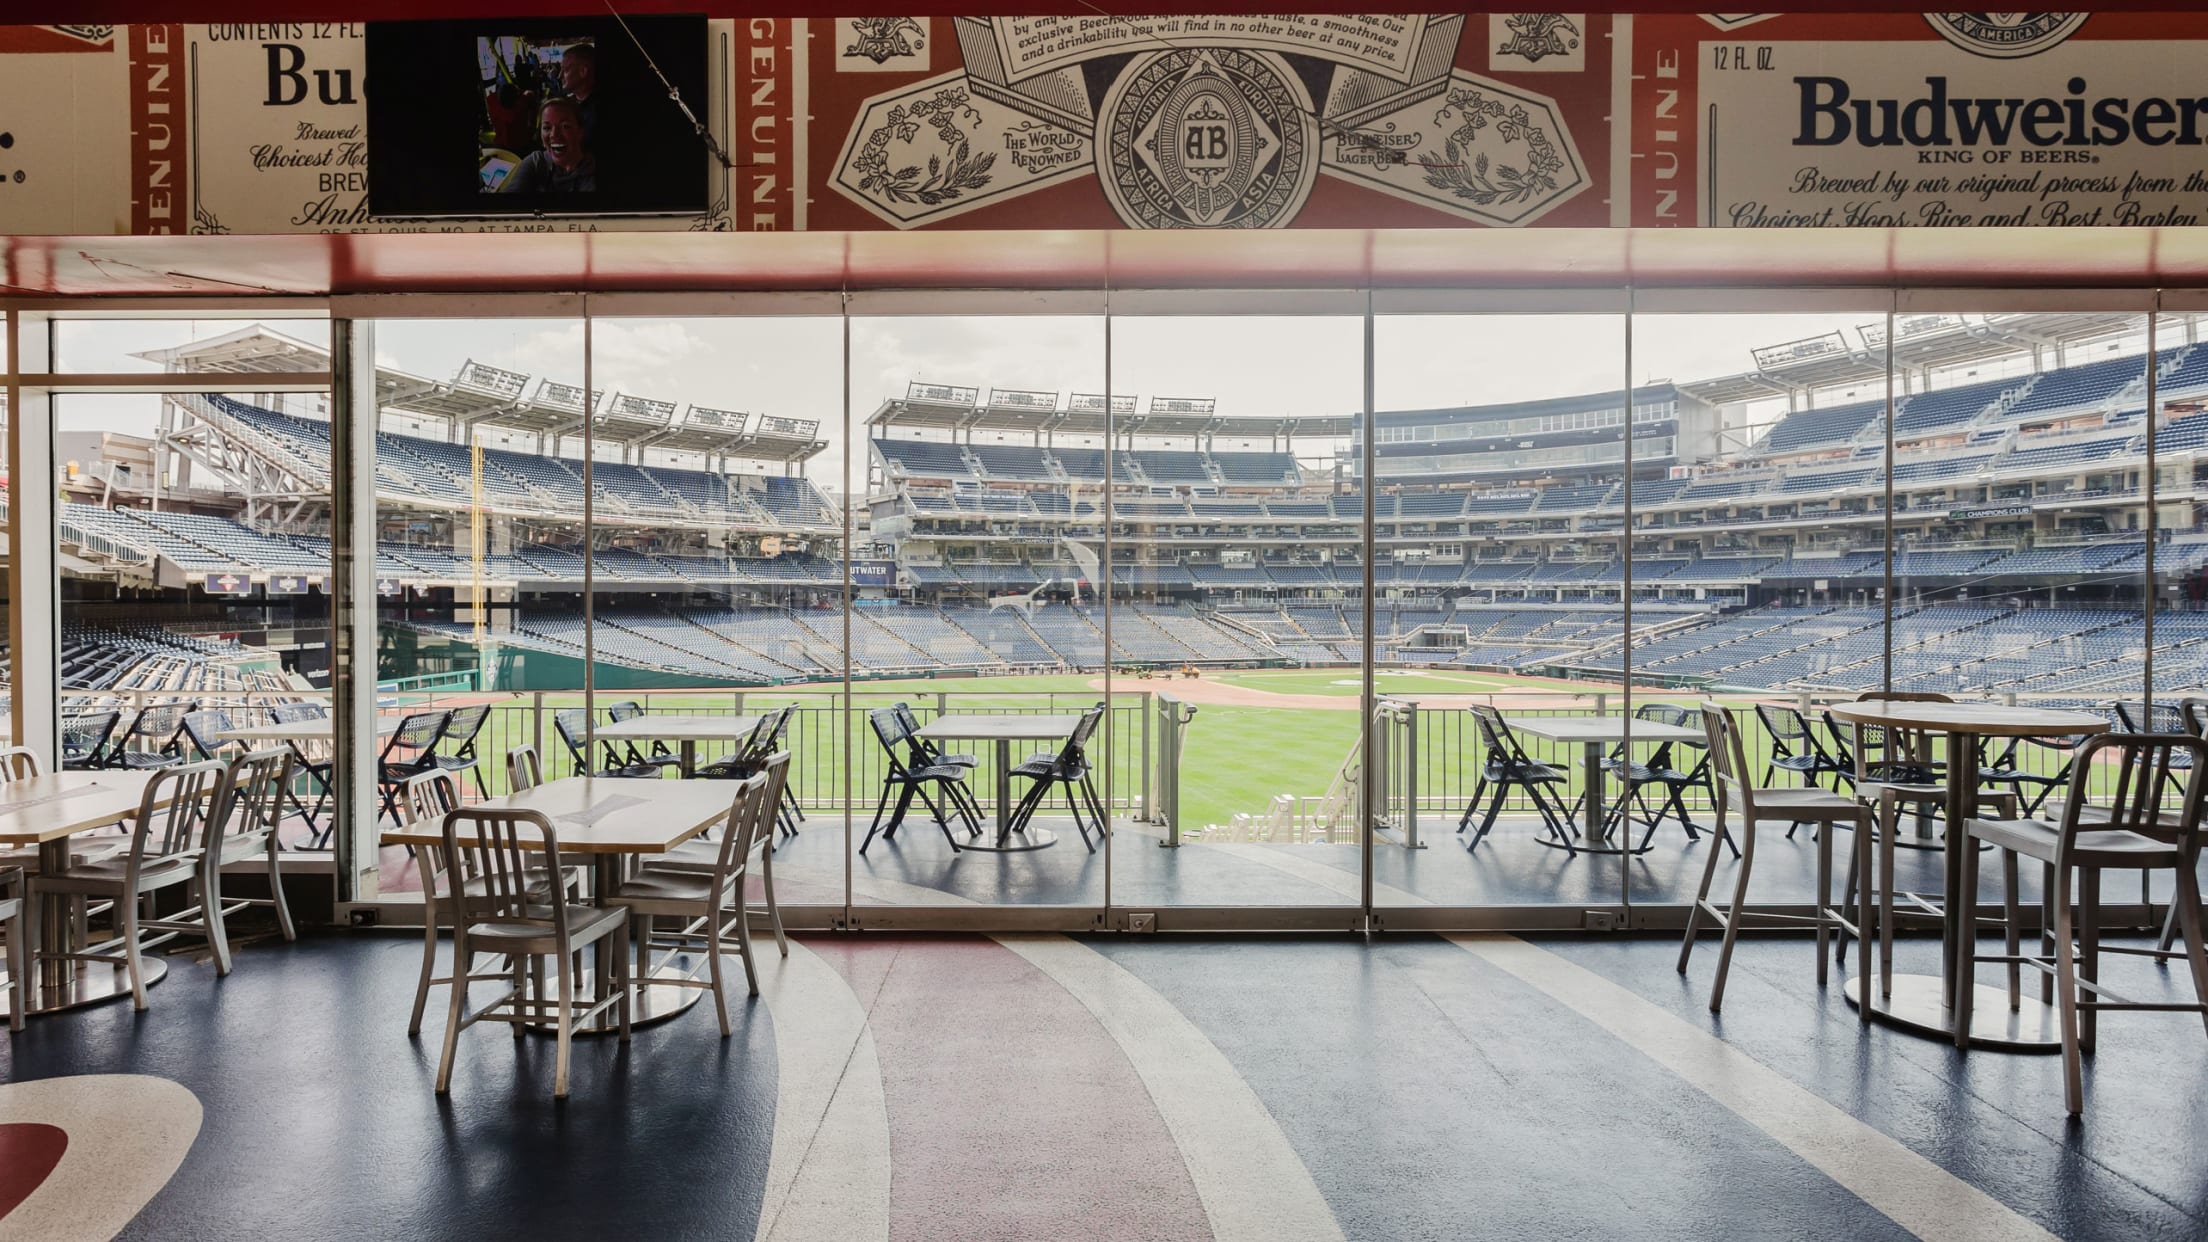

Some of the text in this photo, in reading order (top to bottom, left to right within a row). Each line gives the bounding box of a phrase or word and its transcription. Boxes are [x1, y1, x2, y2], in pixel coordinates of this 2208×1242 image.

[1014, 24, 1029, 36] by
[1035, 15, 1058, 29] any
[1018, 25, 1074, 48] exclusive
[1310, 17, 1319, 26] a
[1323, 20, 1400, 48] smoothness
[1382, 18, 1405, 34] Our
[1979, 28, 2034, 42] AMERICA
[1021, 20, 1396, 62] and a drinkability you will find in no other beer at any price.
[1713, 46, 1728, 70] 12
[1136, 79, 1178, 129] AUSTRALIA
[1238, 80, 1276, 123] EUROPE
[1792, 76, 2208, 147] Budweiser
[294, 120, 361, 141] Brewed
[750, 18, 776, 231] GENUINE
[1655, 48, 1679, 227] NUINE
[1002, 131, 1080, 150] THE WORLD
[1185, 126, 1228, 160] AB
[249, 144, 334, 172] Choicest
[1011, 150, 1082, 168] RENOWNED
[1335, 147, 1375, 165] LAGER
[1918, 150, 1974, 164] KING
[1982, 150, 2012, 164] OF
[1137, 167, 1174, 211] AFRICA
[1242, 172, 1275, 209] ASIA
[1789, 165, 1880, 194] Brewed
[1880, 170, 1910, 201] by
[1913, 176, 1951, 194] our
[1950, 170, 2042, 202] original
[2039, 175, 2121, 202] process
[2120, 169, 2178, 201] from
[850, 566, 887, 575] UTWATER
